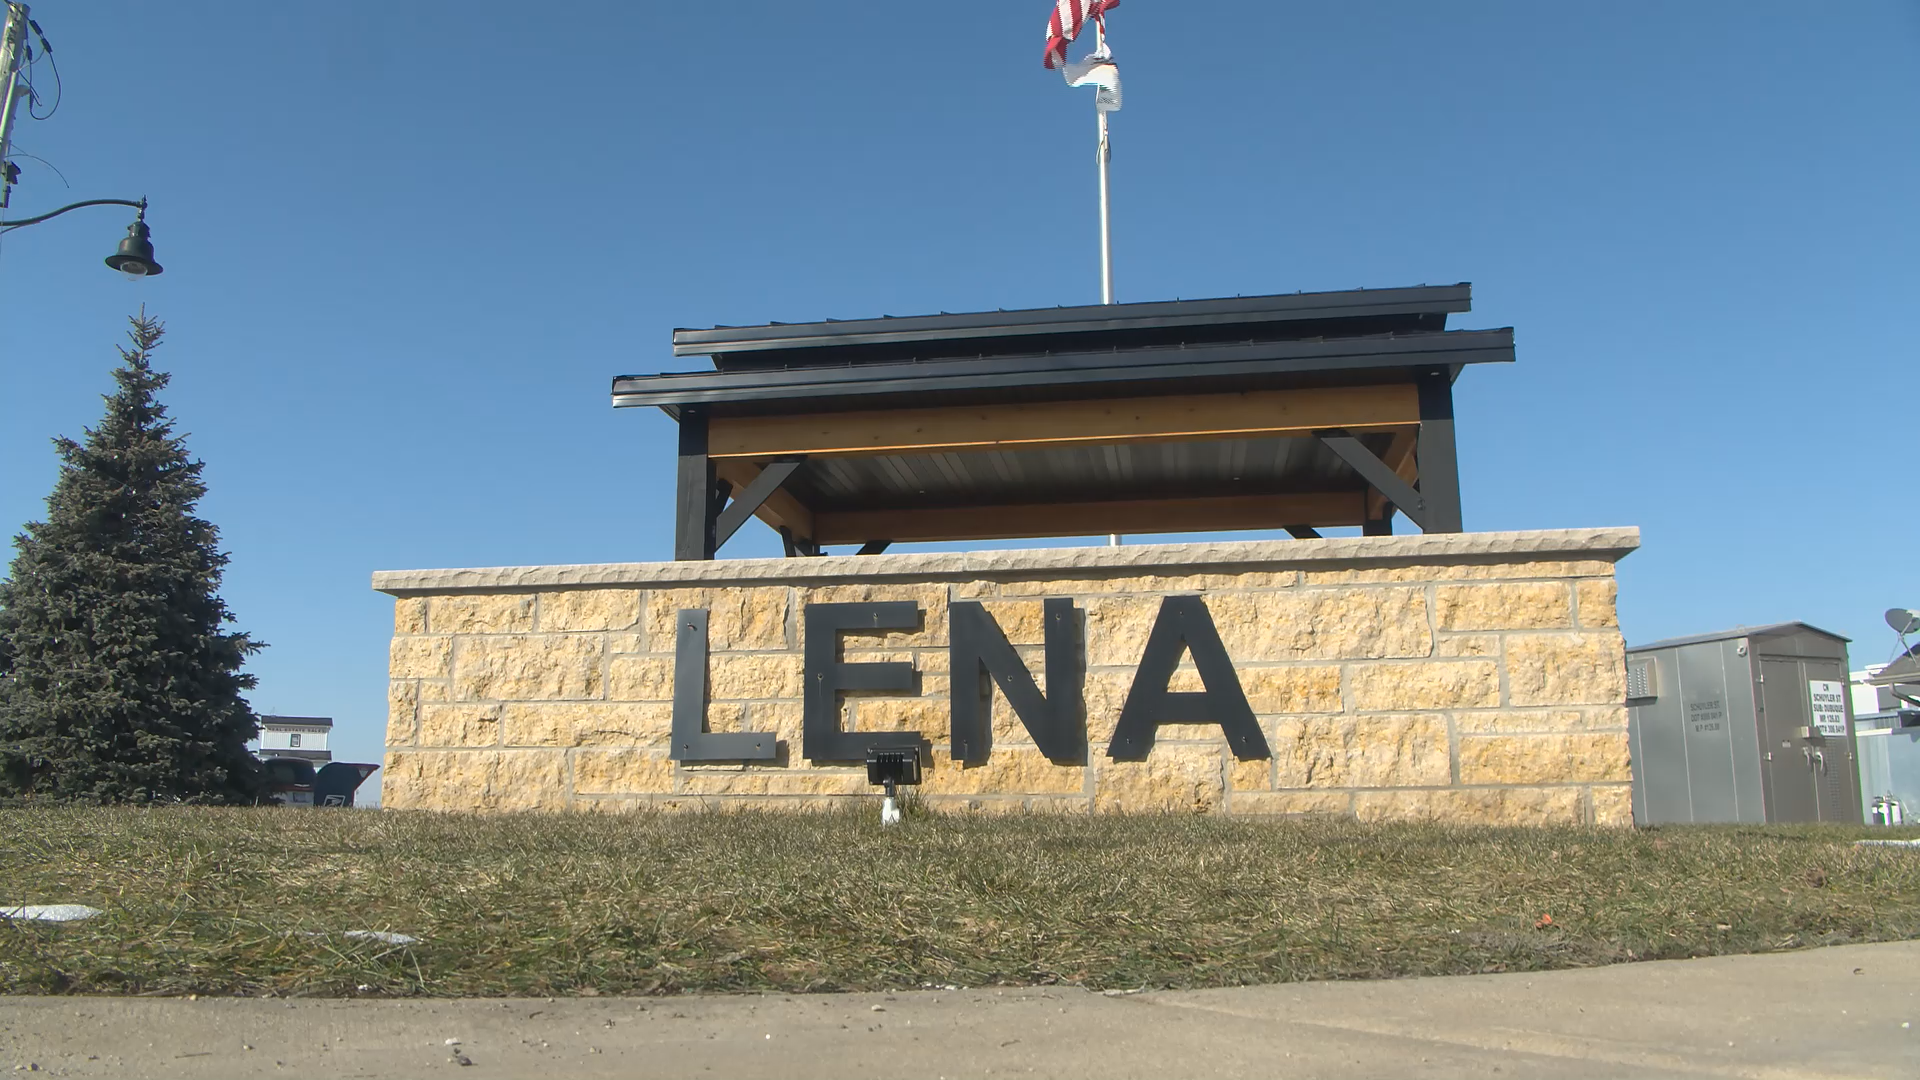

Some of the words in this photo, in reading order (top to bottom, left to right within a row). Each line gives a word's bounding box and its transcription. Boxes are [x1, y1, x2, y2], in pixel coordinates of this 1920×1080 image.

[670, 596, 1271, 763] LENA
[1822, 683, 1829, 691] CN
[1813, 693, 1835, 702] SCHUYLER
